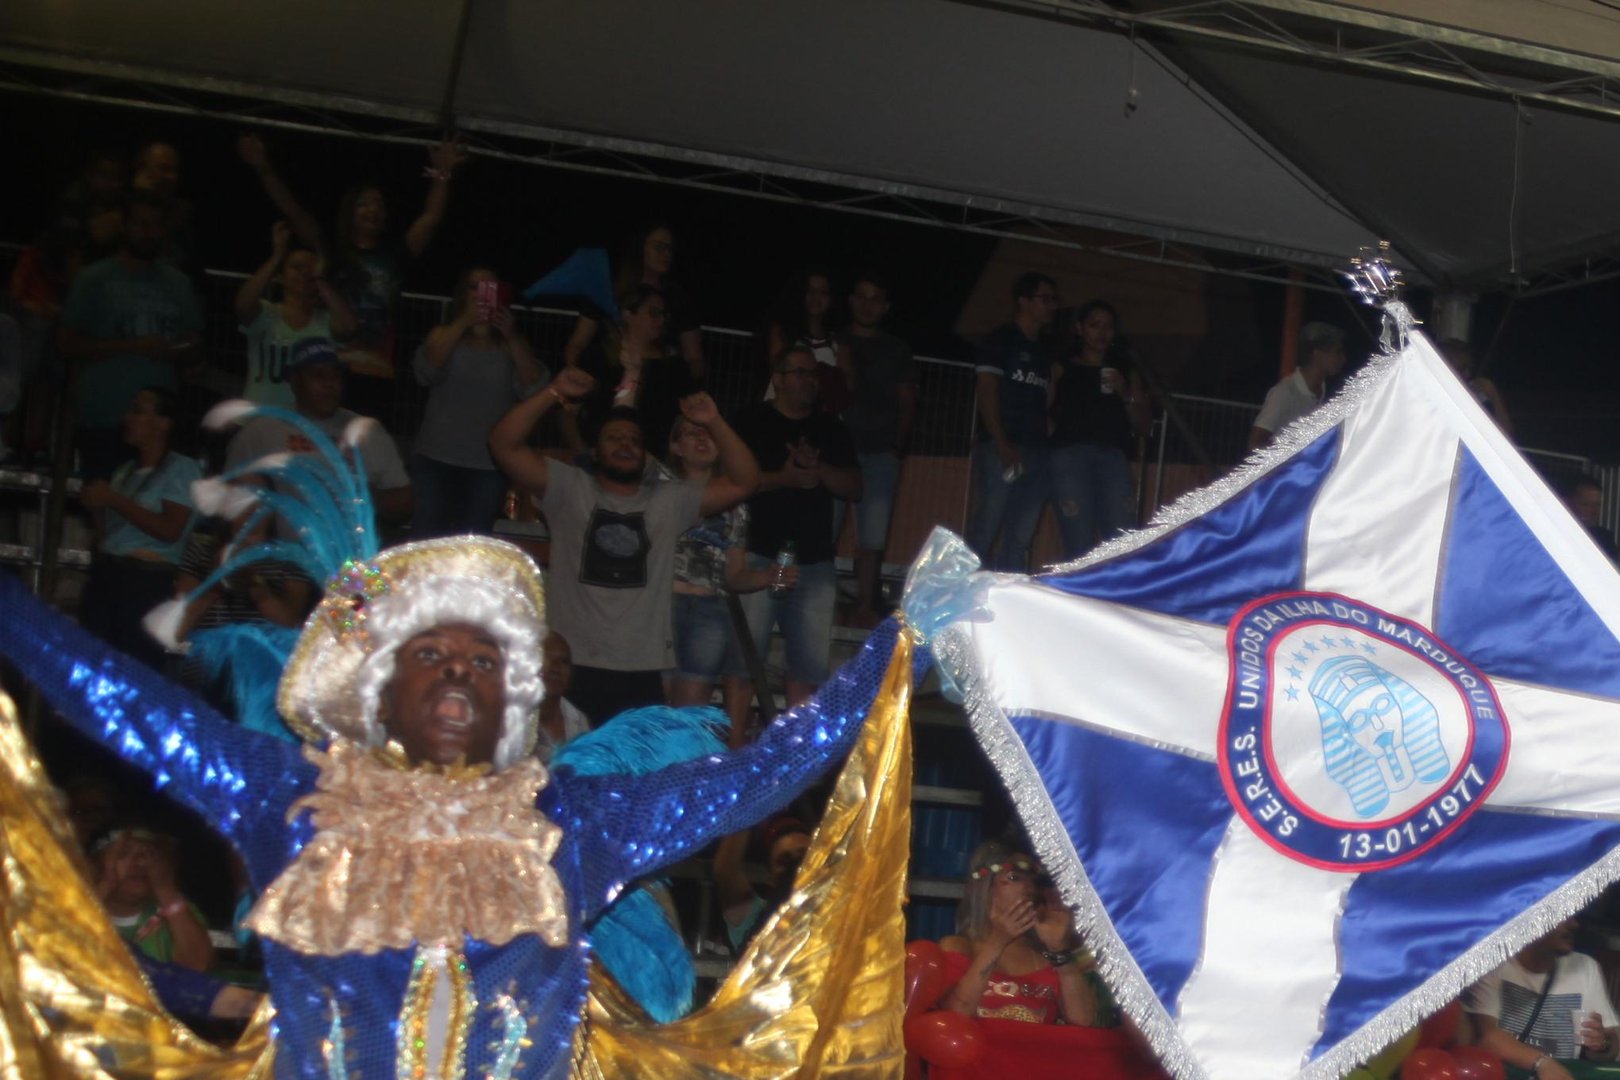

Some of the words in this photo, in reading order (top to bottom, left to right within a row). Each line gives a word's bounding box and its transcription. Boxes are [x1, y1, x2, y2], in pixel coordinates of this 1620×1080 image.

[1332, 602, 1368, 624] DO
[1238, 627, 1264, 709] UNIDOS
[1378, 618, 1494, 719] MARDUQUE
[1234, 726, 1299, 836] S.E.R.E.S.
[1340, 763, 1485, 858] 13-01-1977
